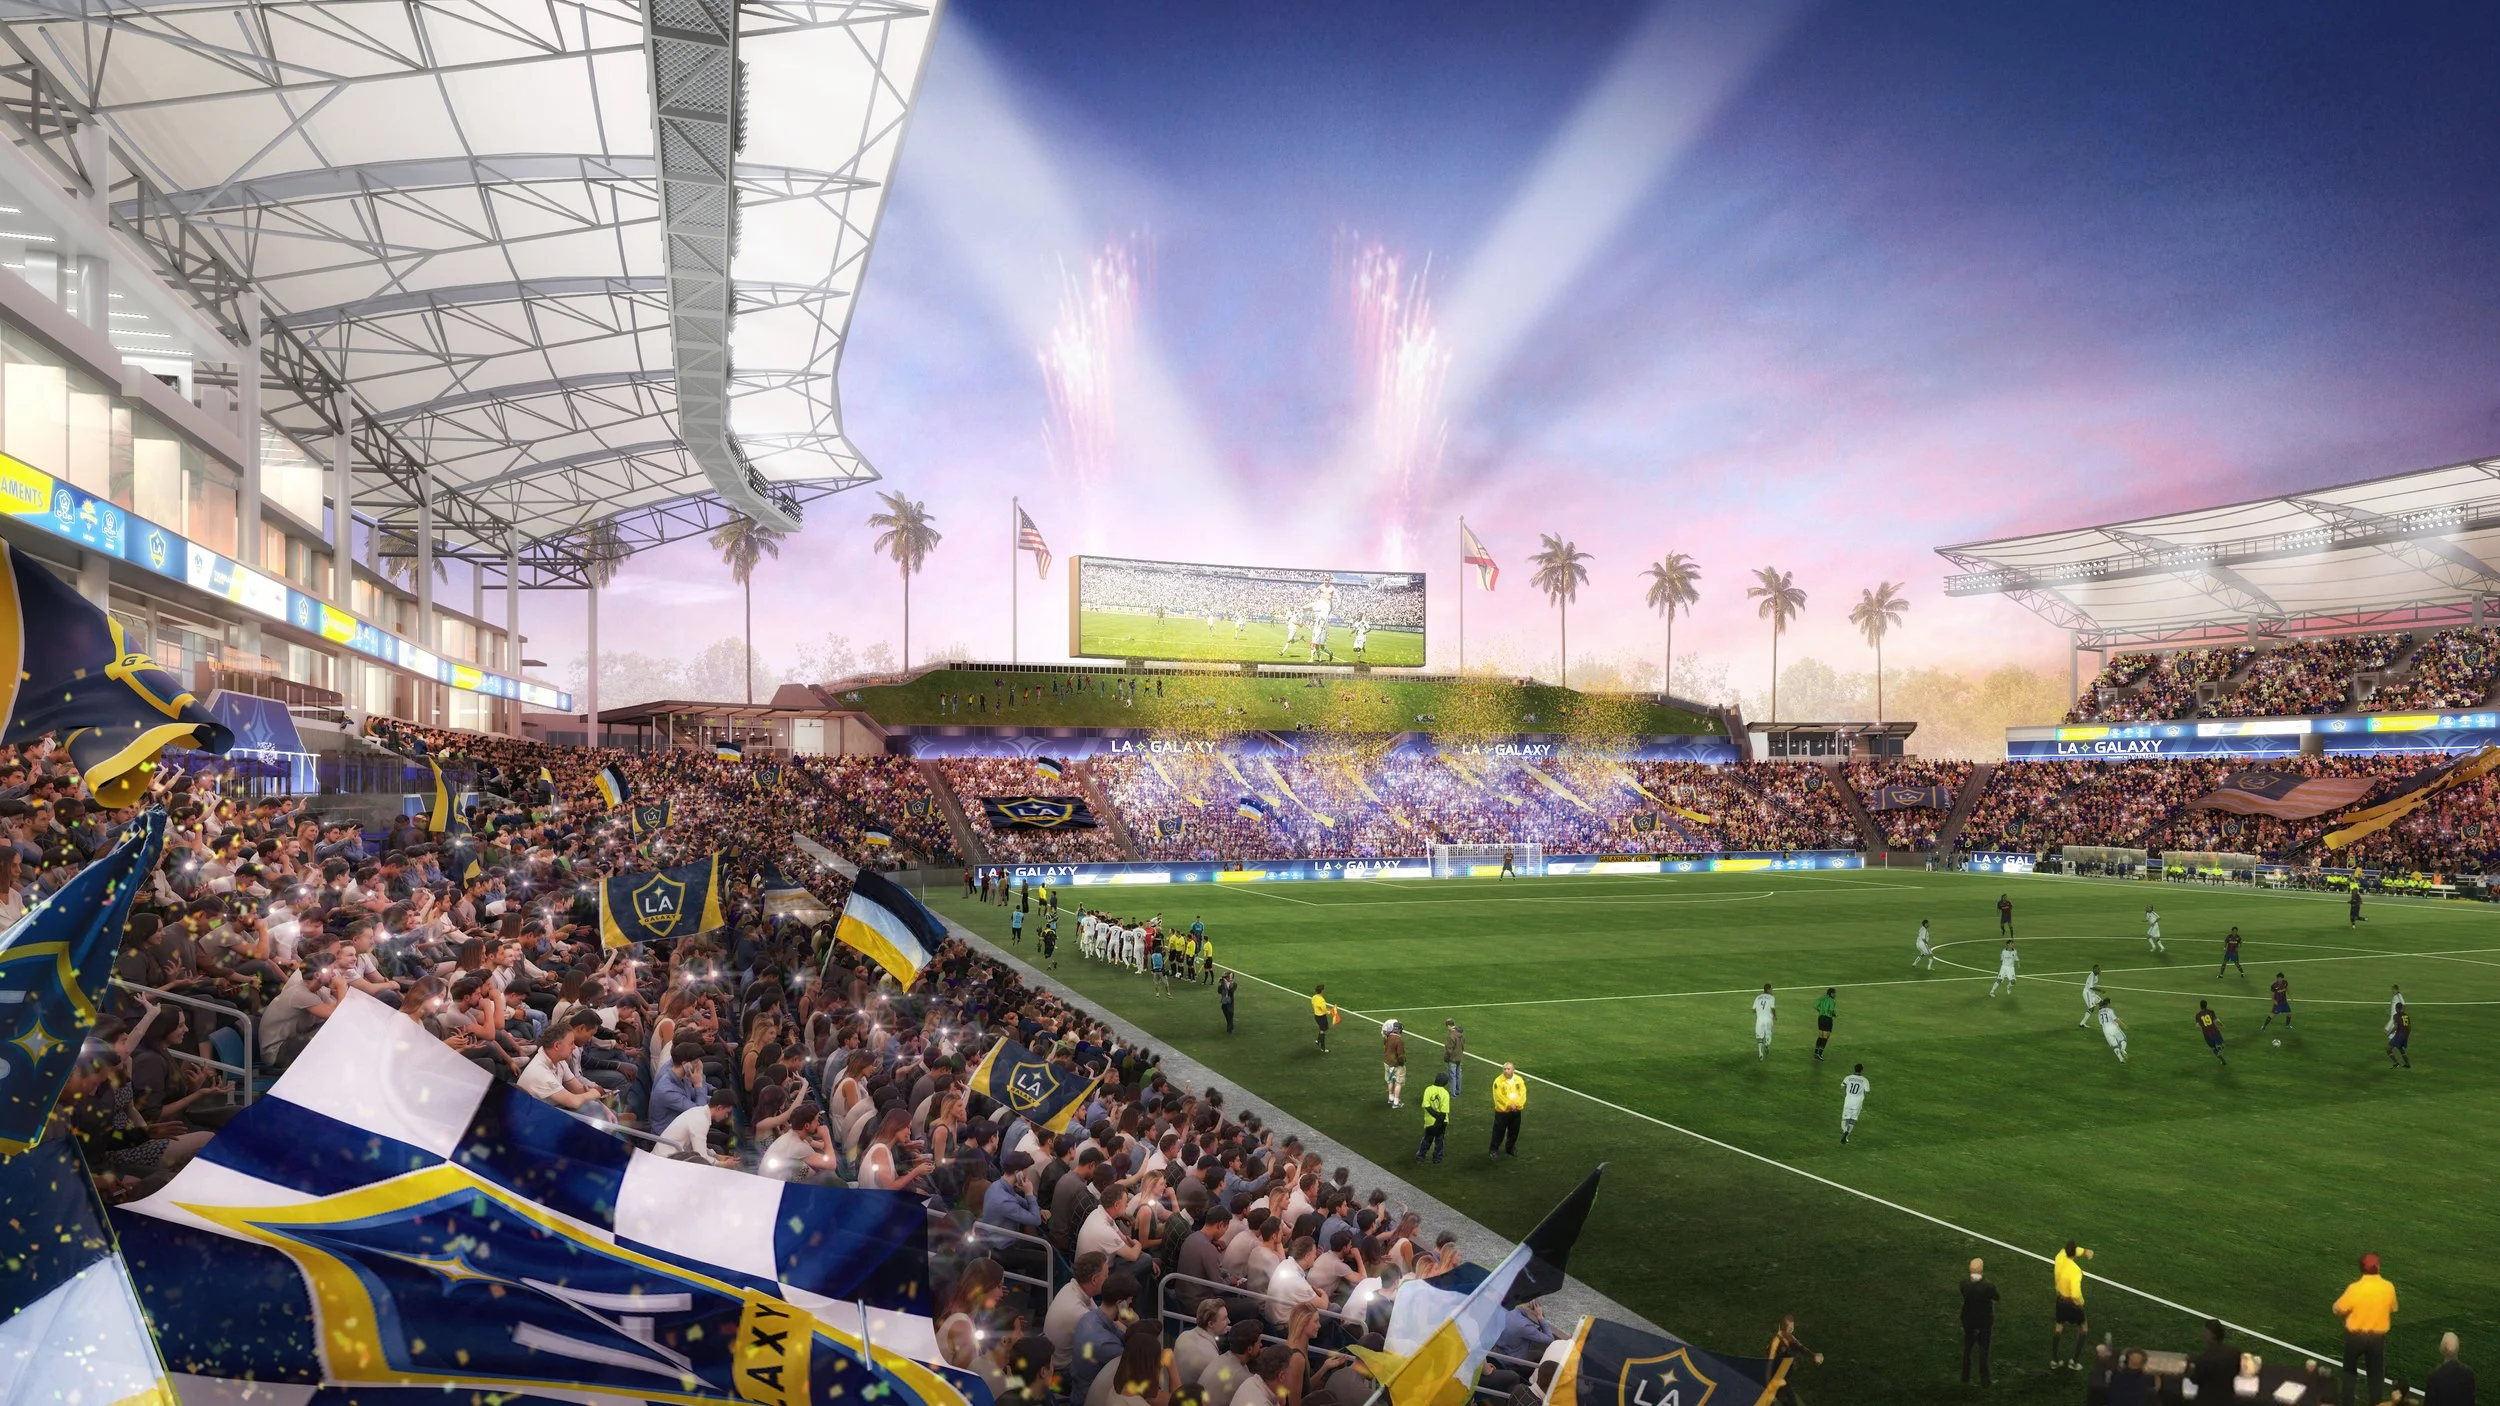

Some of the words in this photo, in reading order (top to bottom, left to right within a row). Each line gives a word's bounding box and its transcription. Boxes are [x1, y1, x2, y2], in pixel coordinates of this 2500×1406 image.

[1111, 740, 1134, 753] LA
[1150, 741, 1216, 754] GALAXY
[1462, 744, 1481, 755] LA
[1495, 744, 1552, 756] GALAXY
[2057, 742, 2079, 754] LA
[2094, 740, 2163, 754] GALAXY
[1018, 808, 1060, 817] LA
[1314, 861, 1332, 871] LA
[1346, 860, 1401, 870] GALAXY
[1974, 854, 1992, 864] LA
[978, 867, 999, 879] LA
[1015, 866, 1079, 876] GALAXY
[645, 895, 674, 913] LA
[644, 914, 678, 923] GALAXY
[1760, 1000, 1767, 1010] 4
[2201, 1014, 2212, 1027] 19
[1017, 1073, 1041, 1096] LA
[1849, 1082, 1860, 1095] 10
[1633, 1379, 1680, 1406] LA
